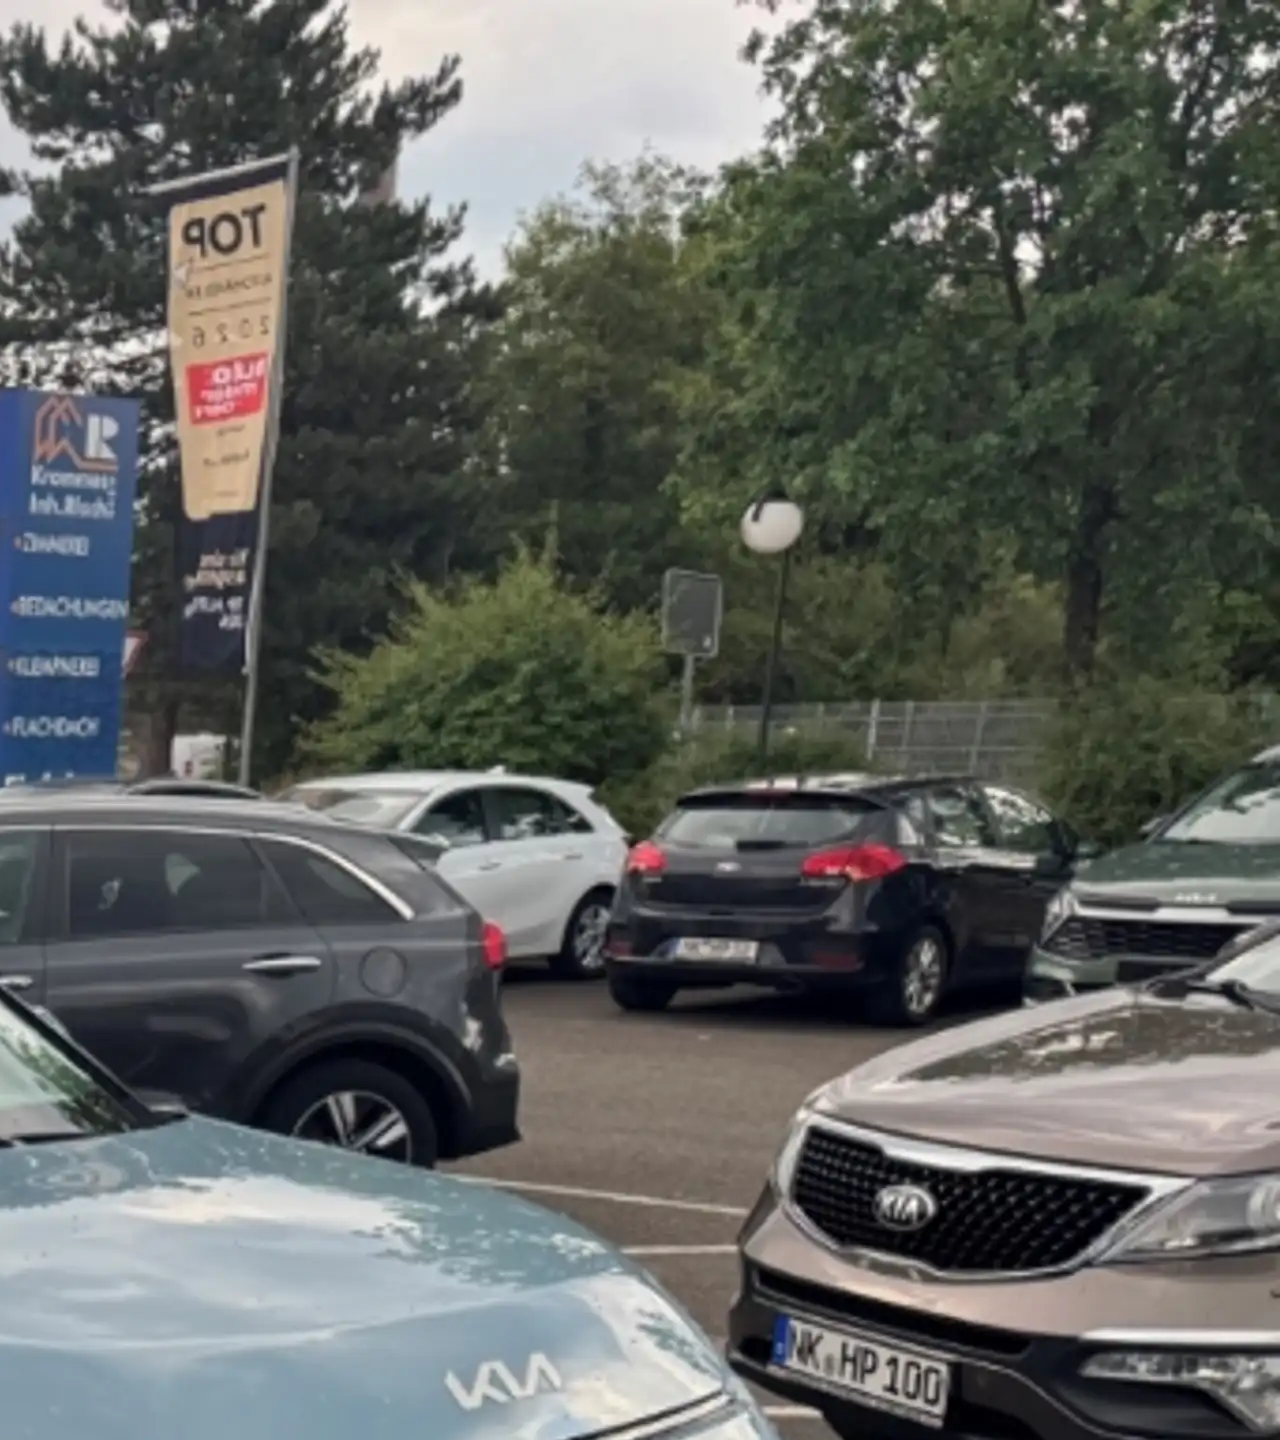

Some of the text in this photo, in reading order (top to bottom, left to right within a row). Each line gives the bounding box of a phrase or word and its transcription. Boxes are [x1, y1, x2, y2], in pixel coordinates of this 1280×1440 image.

[791, 1322, 940, 1405] NK HP 100
